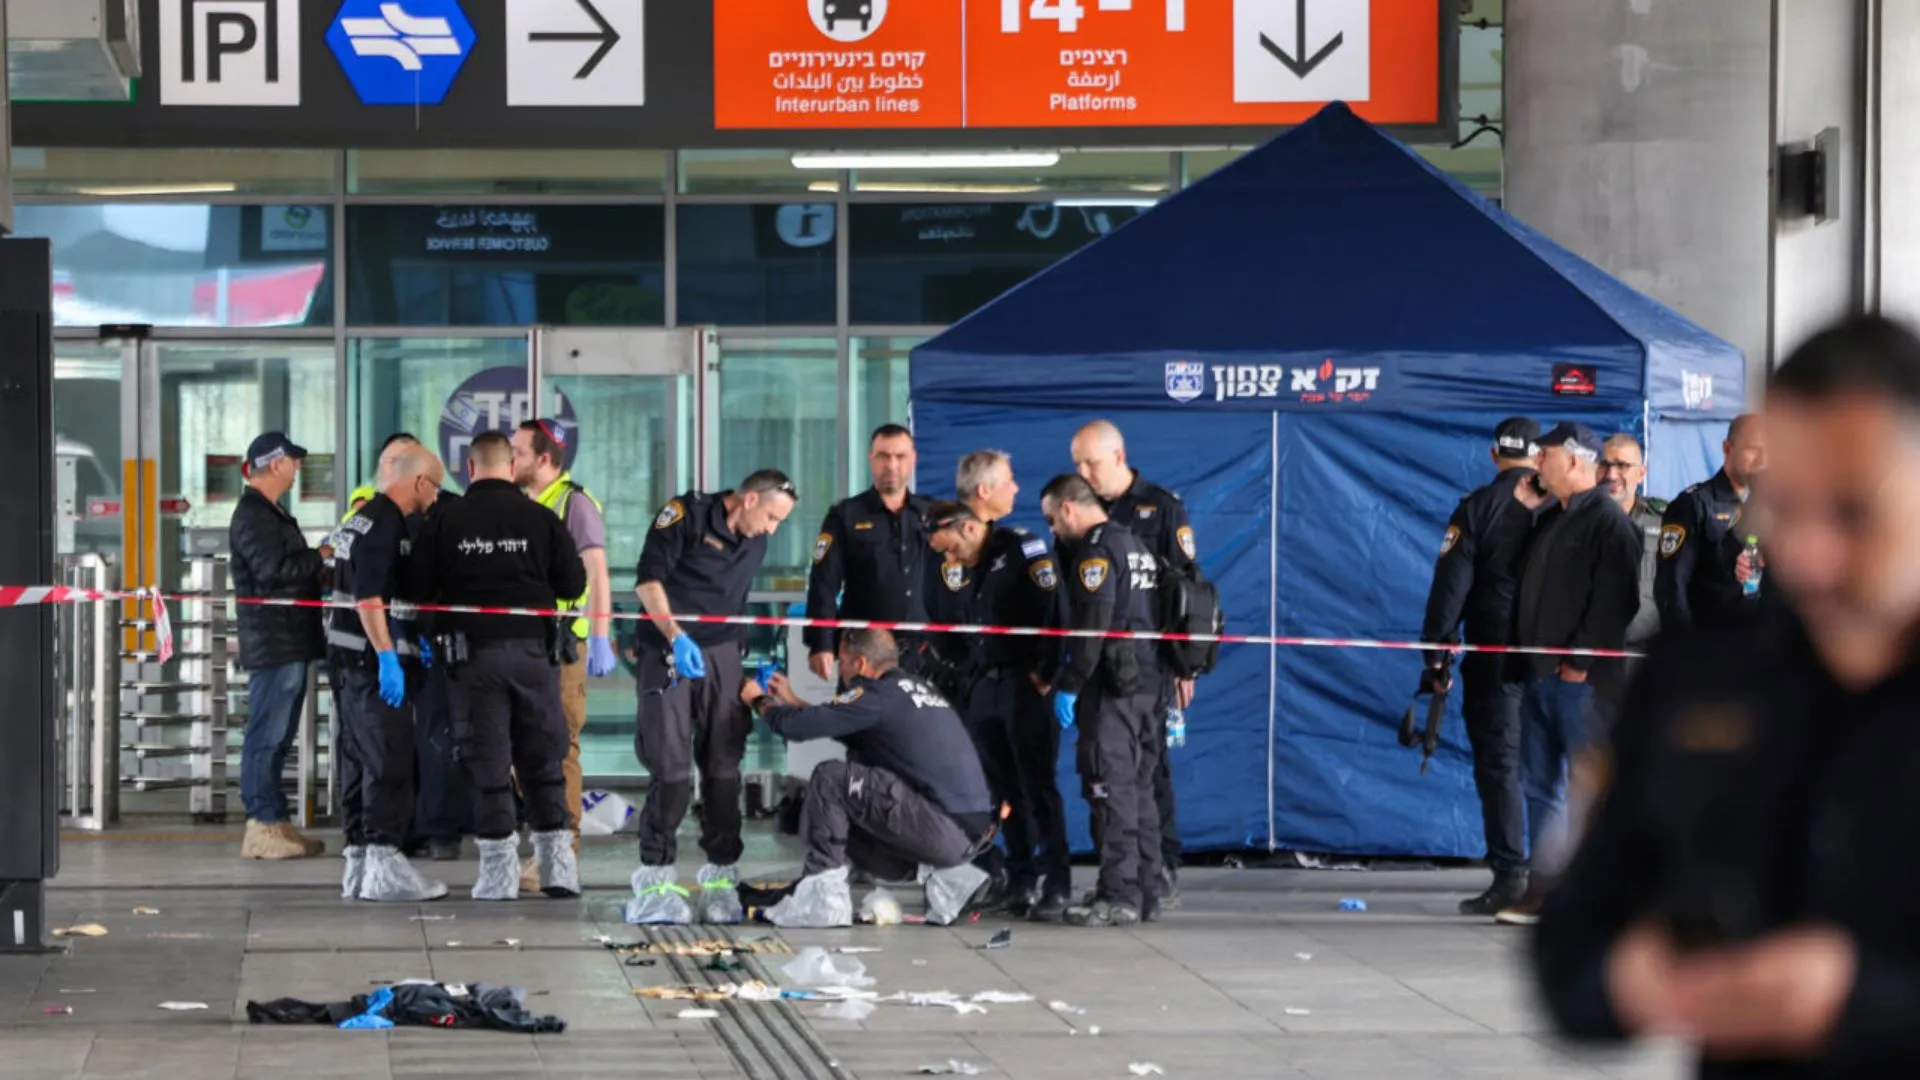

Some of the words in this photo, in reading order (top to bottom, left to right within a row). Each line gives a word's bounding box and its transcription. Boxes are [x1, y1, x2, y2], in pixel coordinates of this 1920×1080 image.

[768, 51, 876, 68] בינעירוניים
[882, 51, 926, 71] קוים
[1059, 49, 1128, 66] רציפים
[869, 71, 924, 94] خطوط
[775, 95, 870, 113] Interurban
[875, 95, 920, 113] lines
[1049, 93, 1137, 110] Platforms
